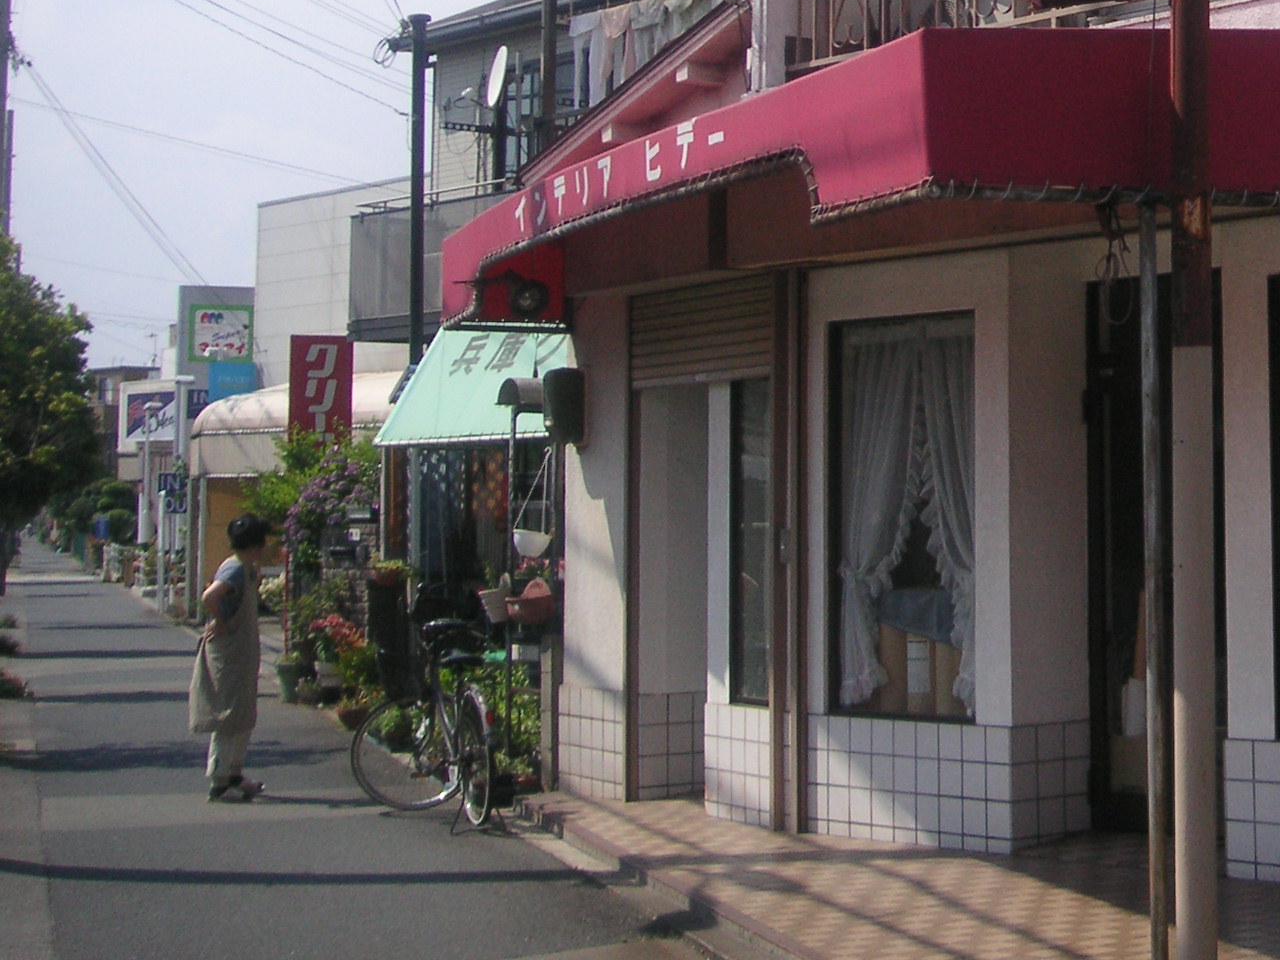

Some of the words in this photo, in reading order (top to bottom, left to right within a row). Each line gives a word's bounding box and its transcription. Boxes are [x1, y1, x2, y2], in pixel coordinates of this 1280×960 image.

[514, 155, 612, 233] インテリア
[305, 343, 338, 443] クリー
